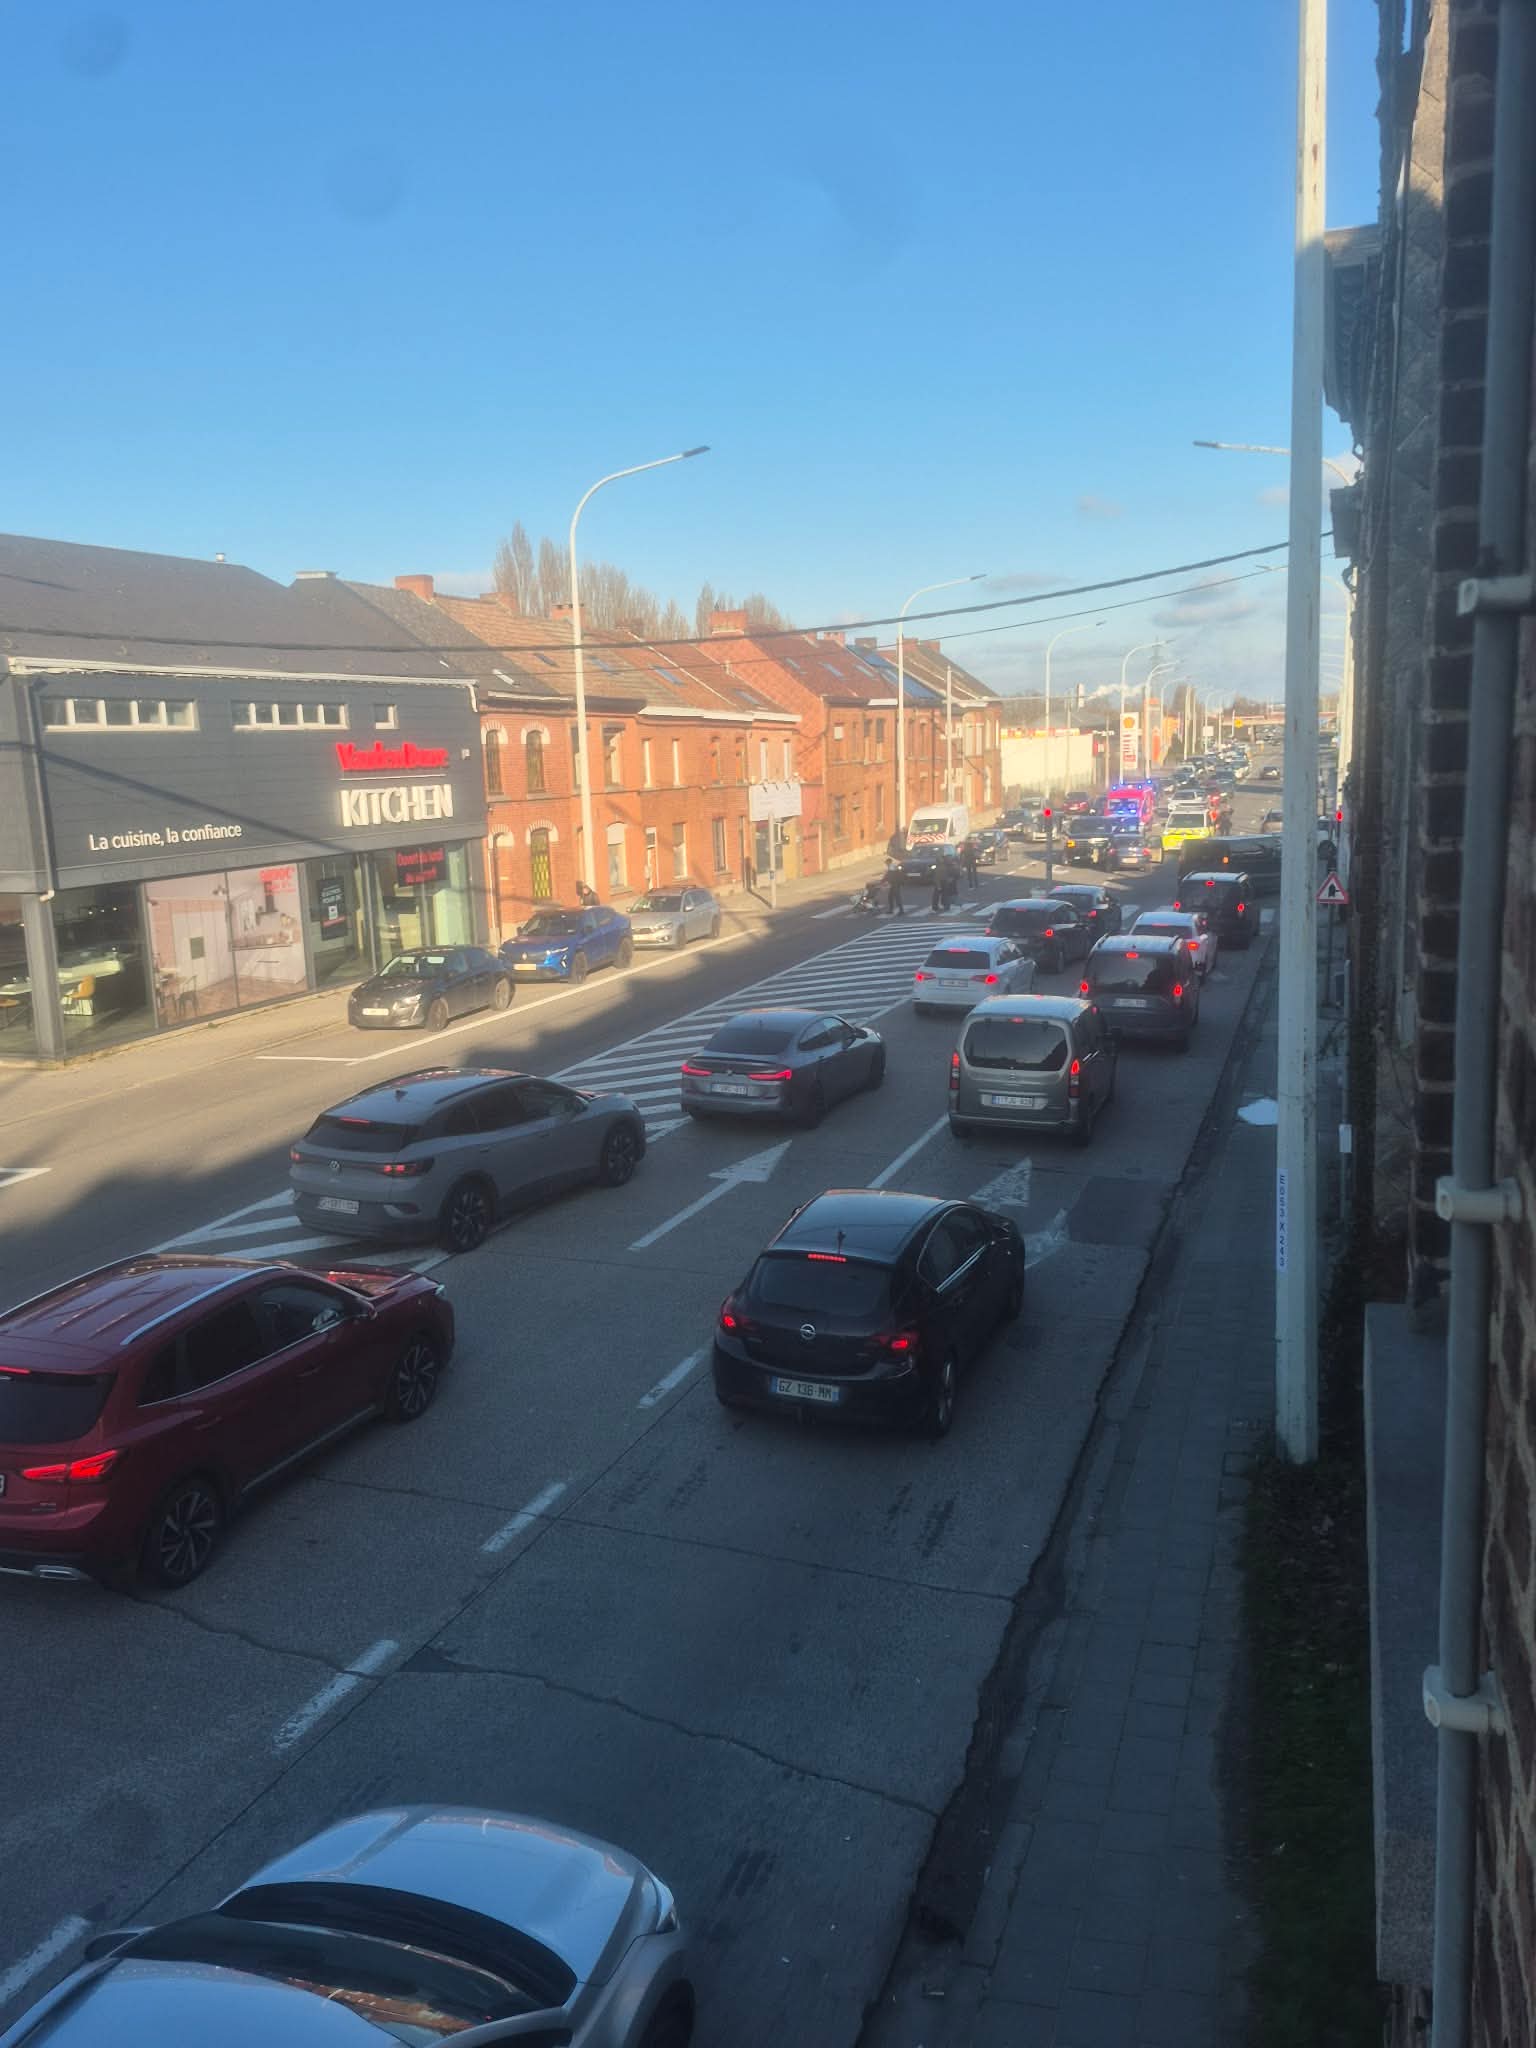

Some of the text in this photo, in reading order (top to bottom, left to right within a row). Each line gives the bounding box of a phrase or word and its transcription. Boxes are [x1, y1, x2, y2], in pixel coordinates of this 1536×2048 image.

[340, 783, 453, 827] KITCHEN
[89, 823, 242, 850] La cuisine, la confiance
